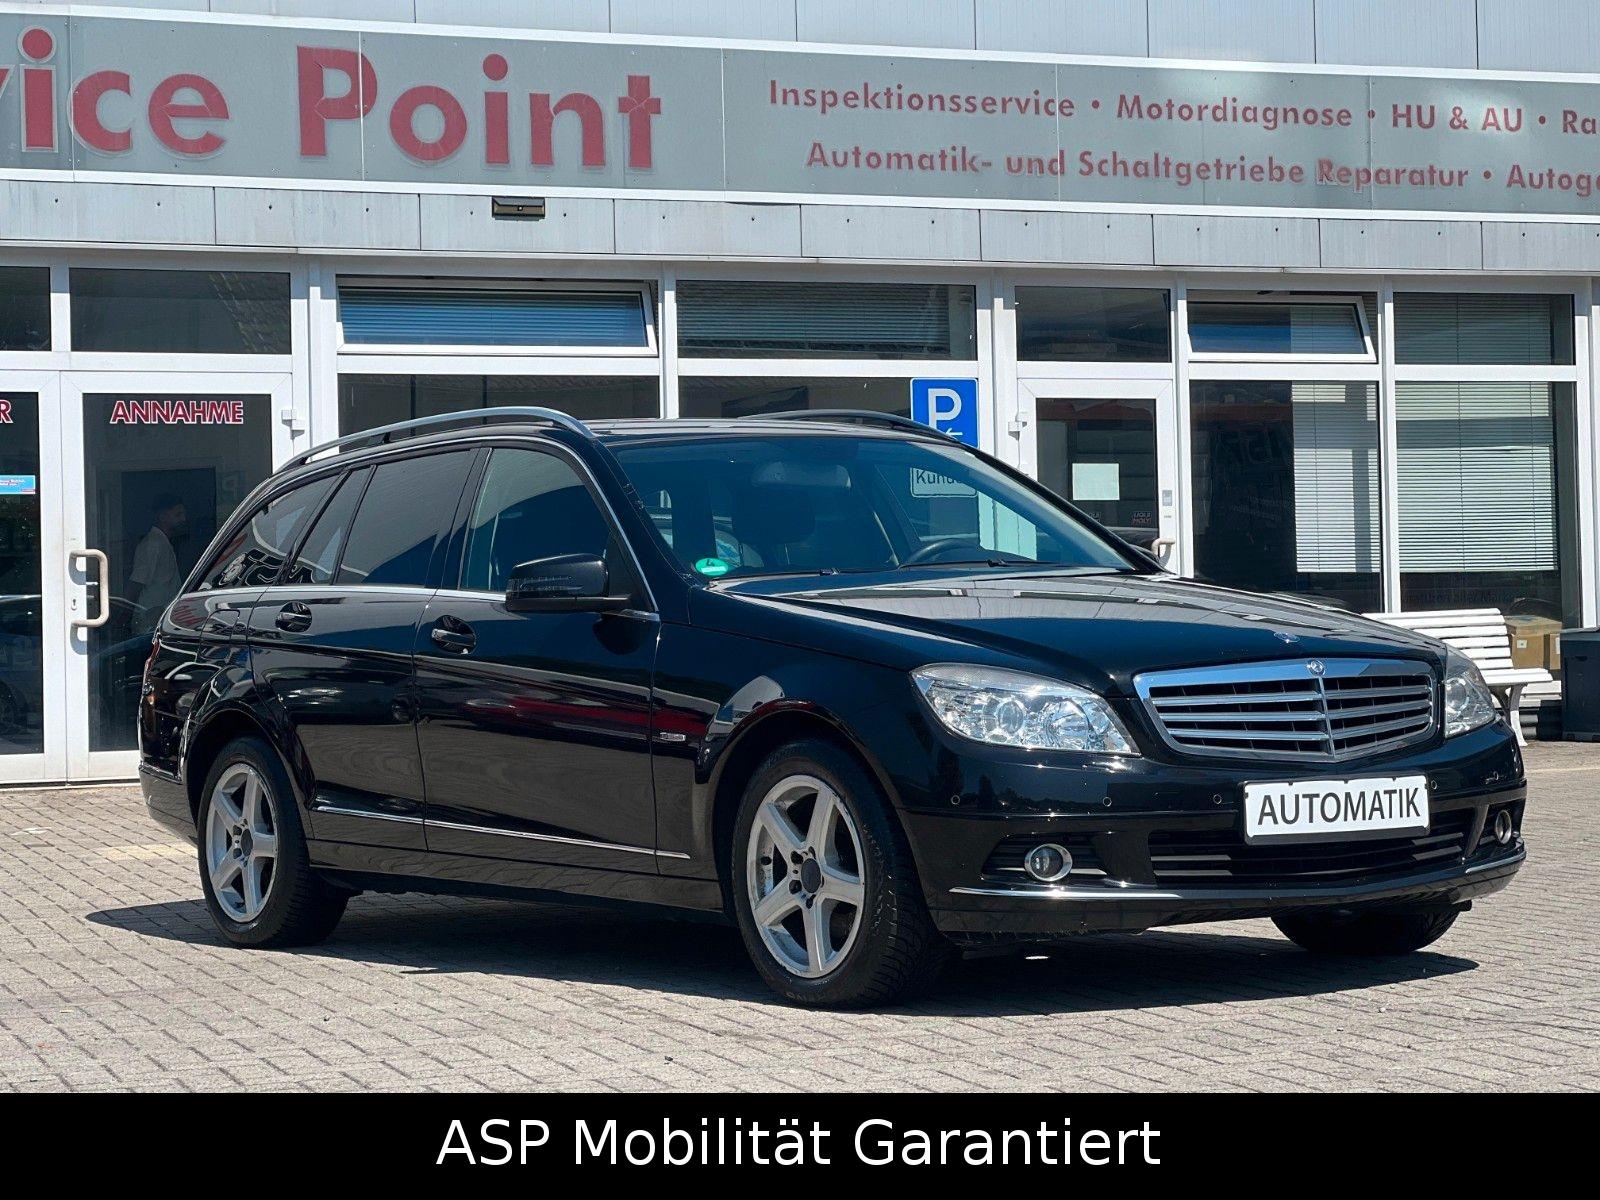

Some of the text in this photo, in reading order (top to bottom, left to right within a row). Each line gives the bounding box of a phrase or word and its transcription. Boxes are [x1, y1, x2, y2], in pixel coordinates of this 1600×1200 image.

[297, 46, 661, 168] Point
[770, 80, 1597, 134] Inspektionsservice Motordiagnose HU & AU Ra
[806, 142, 992, 174] Automatik-
[1006, 149, 1066, 176] und
[1078, 151, 1304, 186] Schaltgetriebe
[1318, 159, 1469, 192] Reparatur
[109, 400, 244, 424] ANNAHME
[927, 388, 962, 430] P
[1257, 787, 1421, 826] AUTOMATIK
